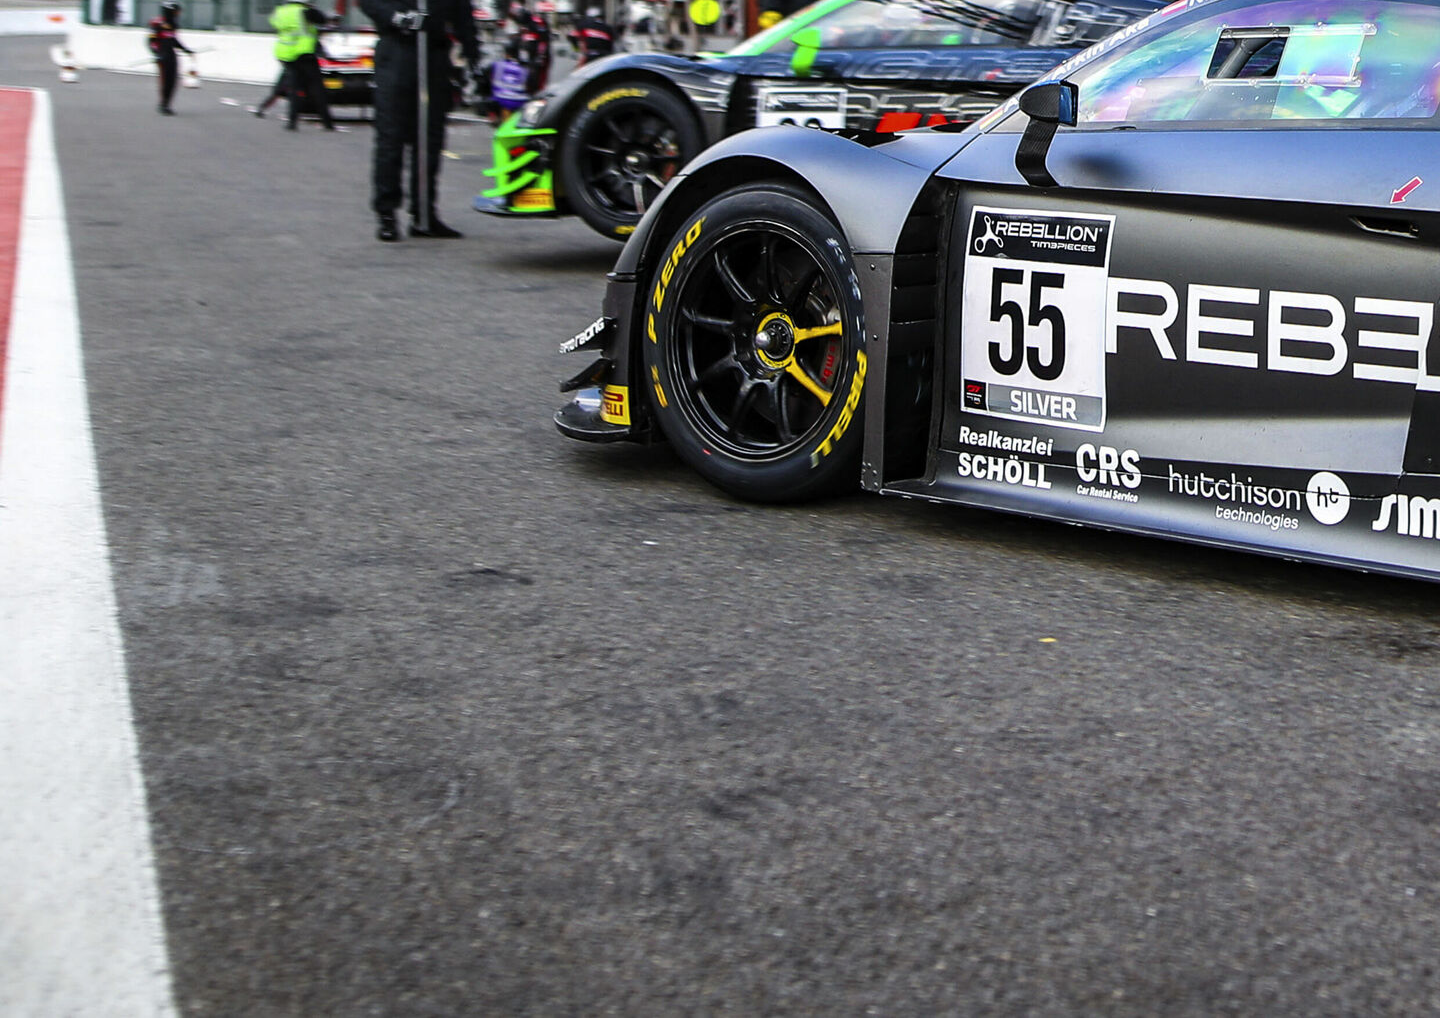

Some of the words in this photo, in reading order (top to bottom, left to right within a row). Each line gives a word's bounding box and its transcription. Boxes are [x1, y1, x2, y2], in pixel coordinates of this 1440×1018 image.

[988, 266, 1067, 382] 55
[1010, 390, 1078, 421] SILVER
[959, 426, 1054, 457] Realkanzlei
[957, 452, 1053, 490] SCHÖLL
[1076, 443, 1142, 489] CRS
[1168, 464, 1301, 512] hutchison
[1316, 486, 1340, 508] ht
[1215, 505, 1299, 531] technologies
